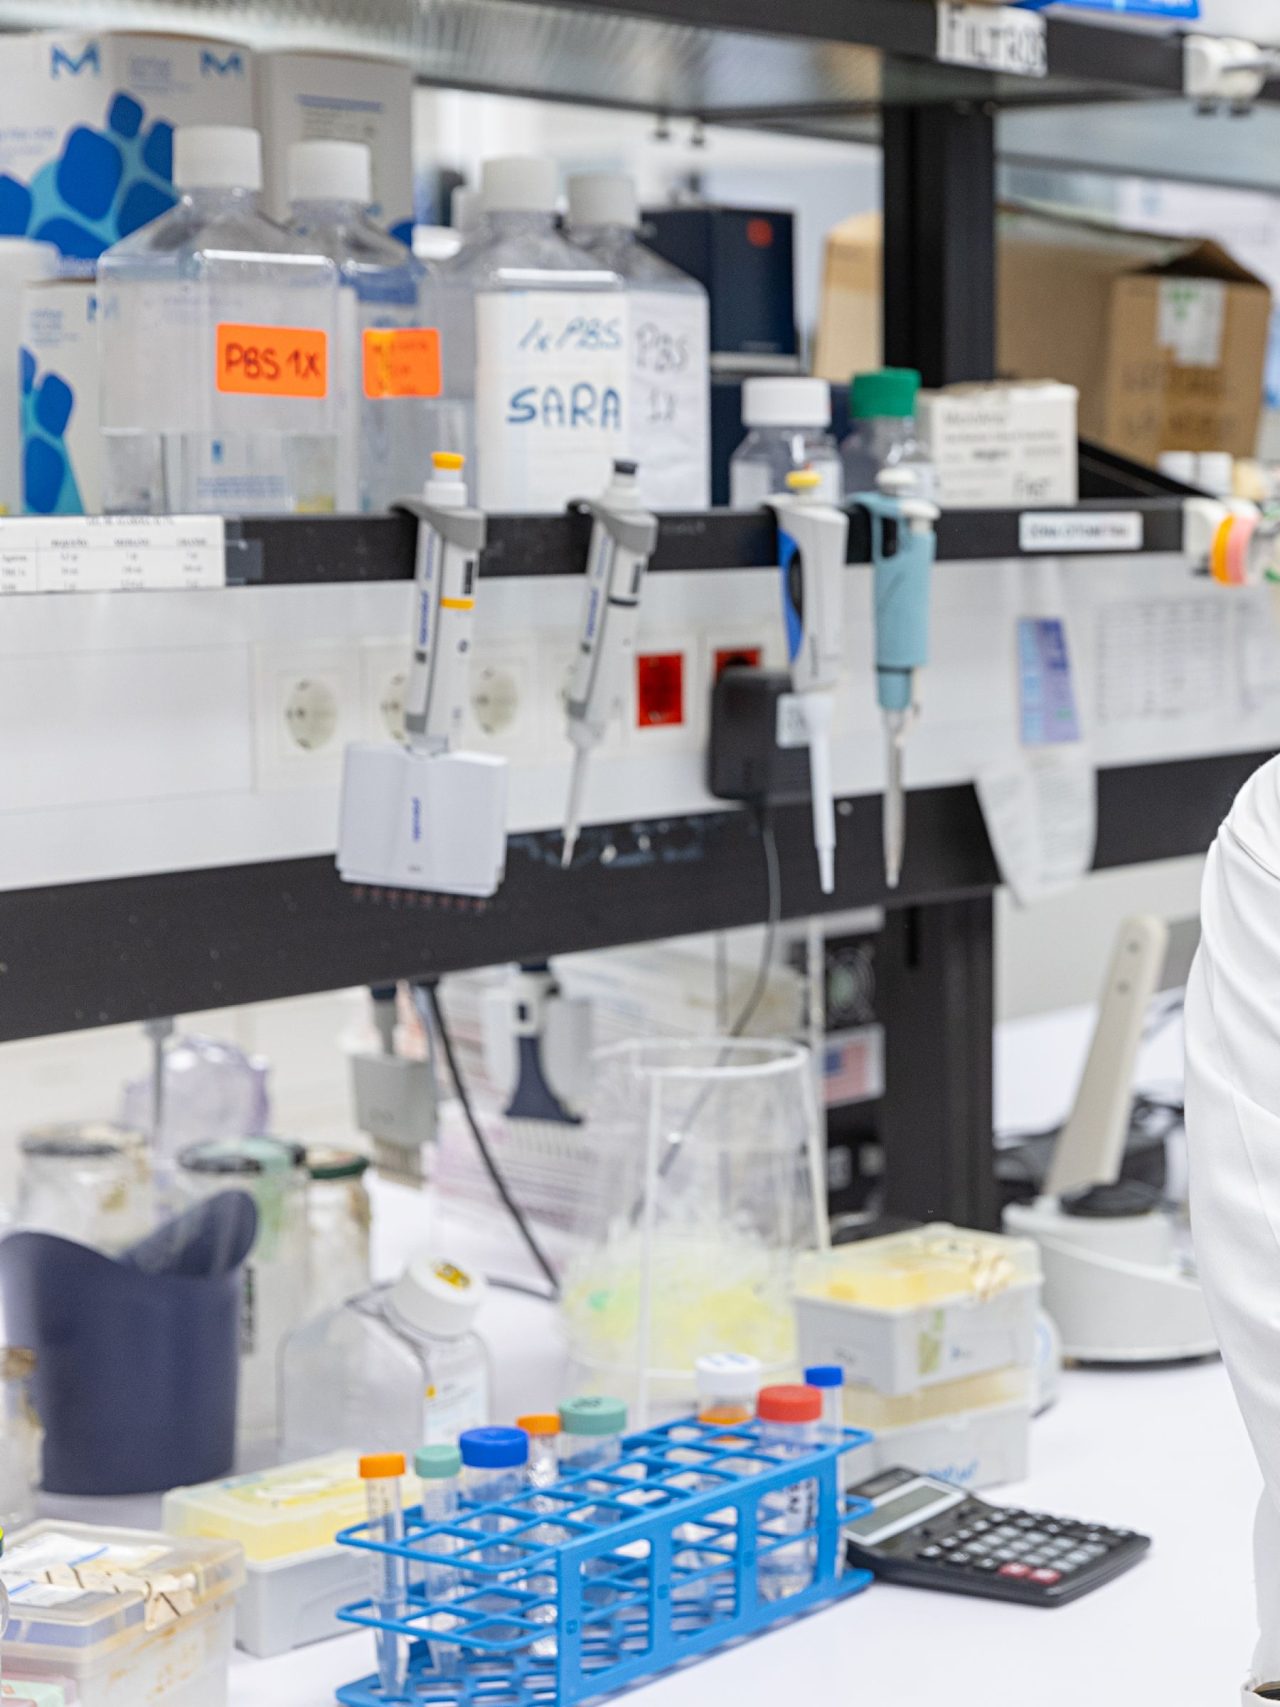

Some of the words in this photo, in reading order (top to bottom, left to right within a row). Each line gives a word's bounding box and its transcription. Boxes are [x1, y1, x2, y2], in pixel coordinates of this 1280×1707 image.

[50, 42, 101, 80] M
[200, 50, 244, 78] M
[555, 315, 623, 348] PBS
[224, 342, 282, 381] PBS
[506, 381, 622, 430] SARA
